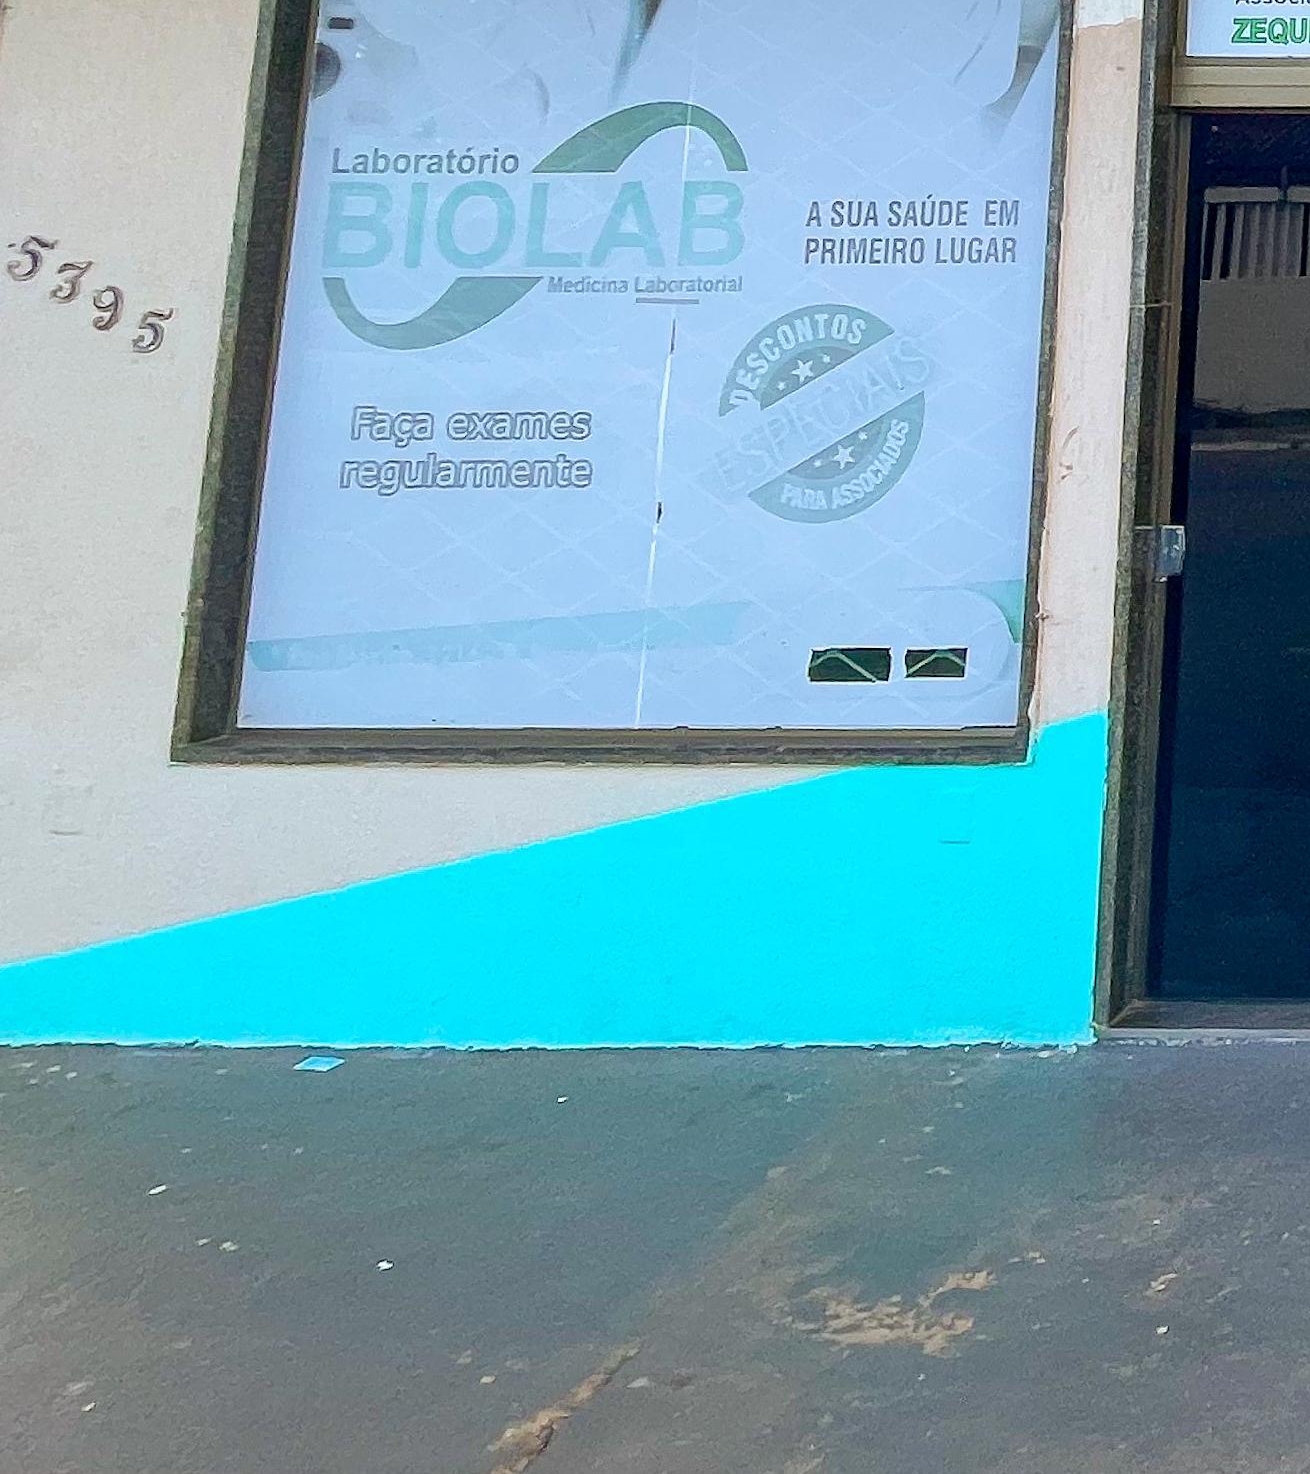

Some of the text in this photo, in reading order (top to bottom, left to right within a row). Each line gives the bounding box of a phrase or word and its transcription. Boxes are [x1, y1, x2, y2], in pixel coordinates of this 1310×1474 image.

[331, 147, 520, 174] Laboratório
[321, 180, 746, 269] BIOLAB
[805, 194, 1019, 227] A SUA SAÚDE EM
[804, 237, 1017, 264] PRIMEIRO LUGAR
[547, 275, 743, 293] Medicina Laboratorial
[728, 312, 867, 406] DESCONTOS
[351, 406, 593, 448] Faça exames
[339, 452, 593, 496] regularmente
[831, 418, 910, 510] ASSOCIADOS
